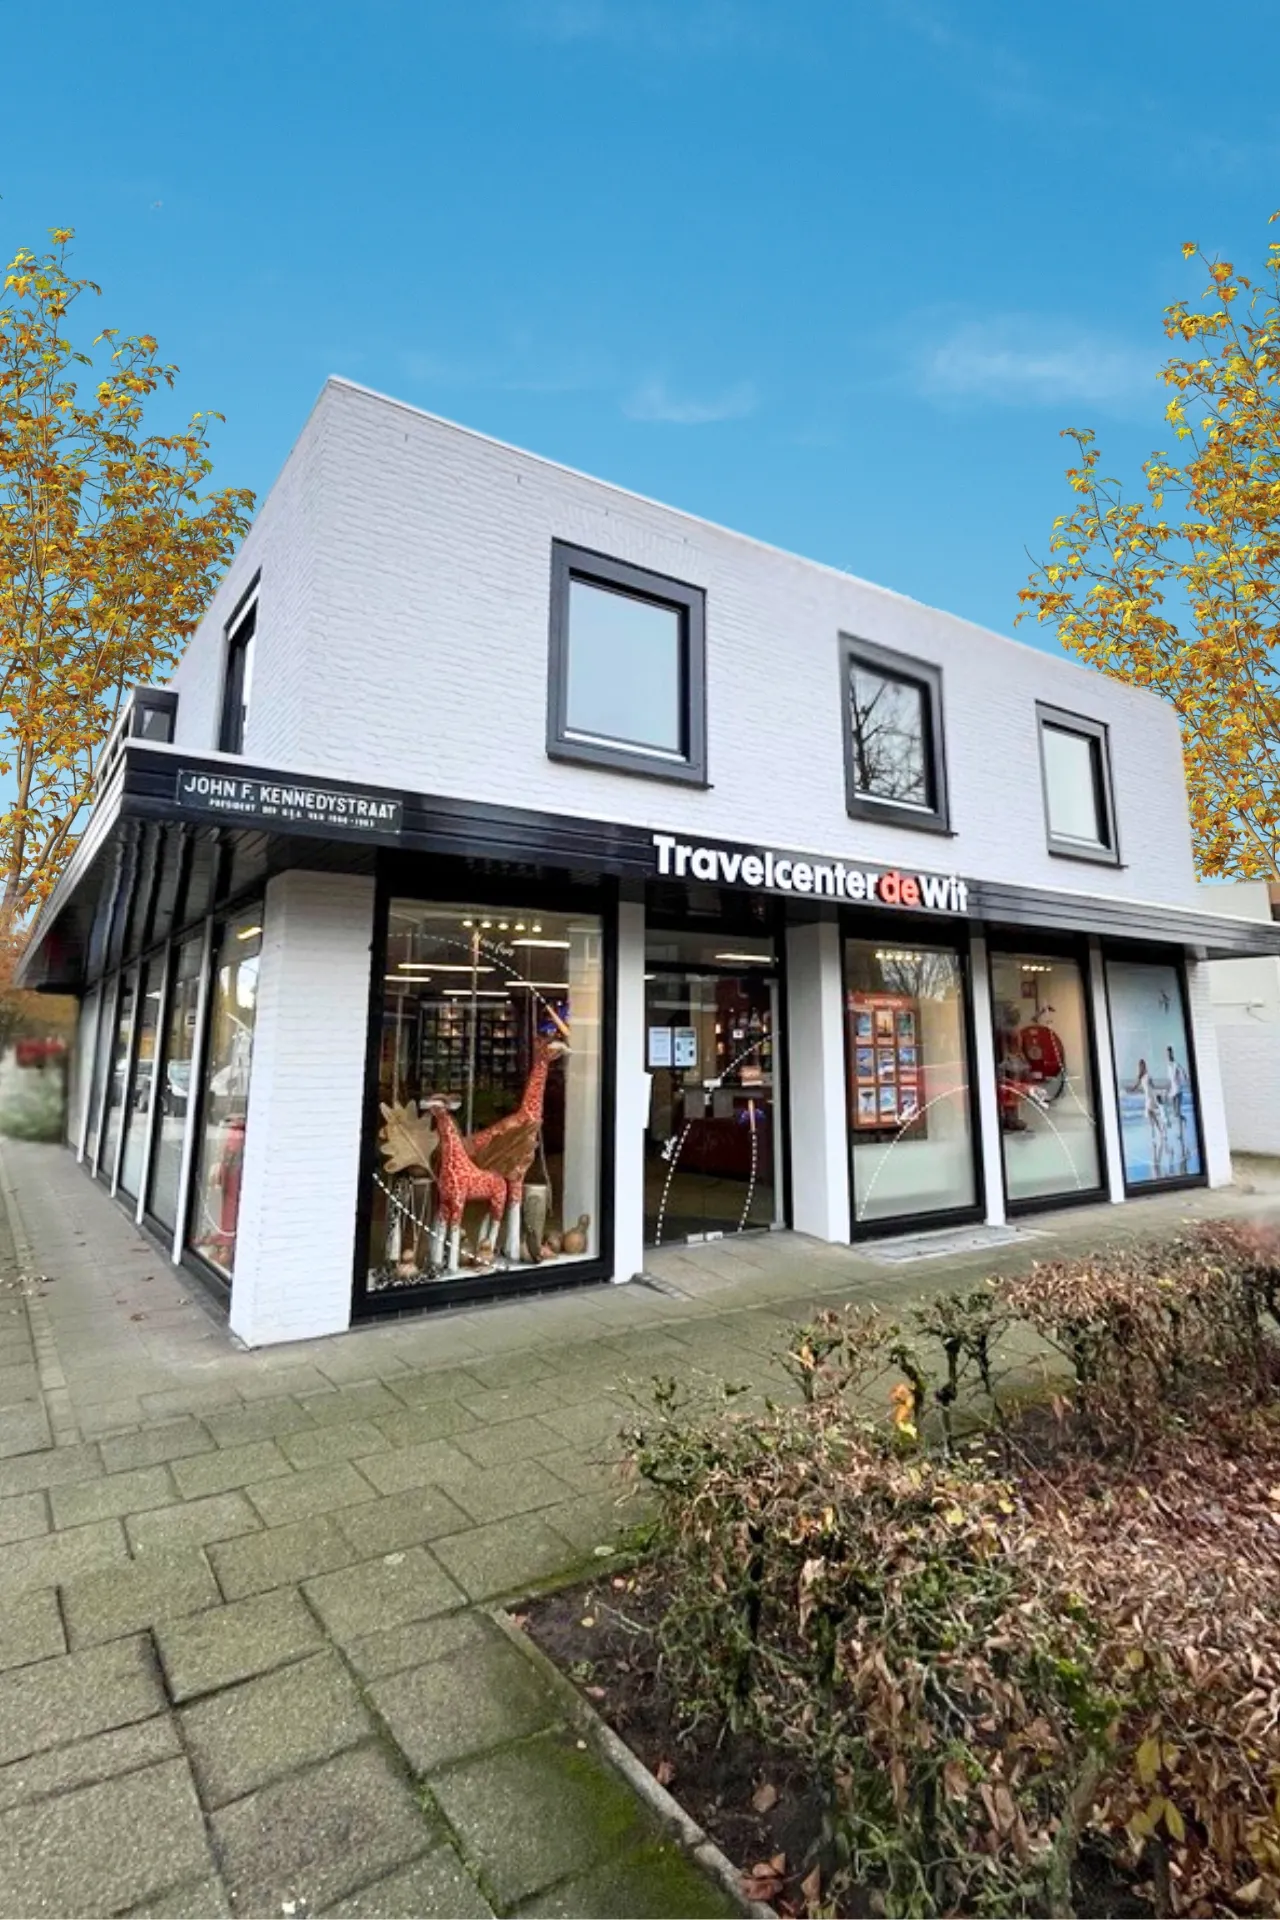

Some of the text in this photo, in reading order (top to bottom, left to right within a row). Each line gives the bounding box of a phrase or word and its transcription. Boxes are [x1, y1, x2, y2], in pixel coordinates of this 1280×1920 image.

[184, 776, 396, 819] JOHN F. KENNEDYSTRAAT
